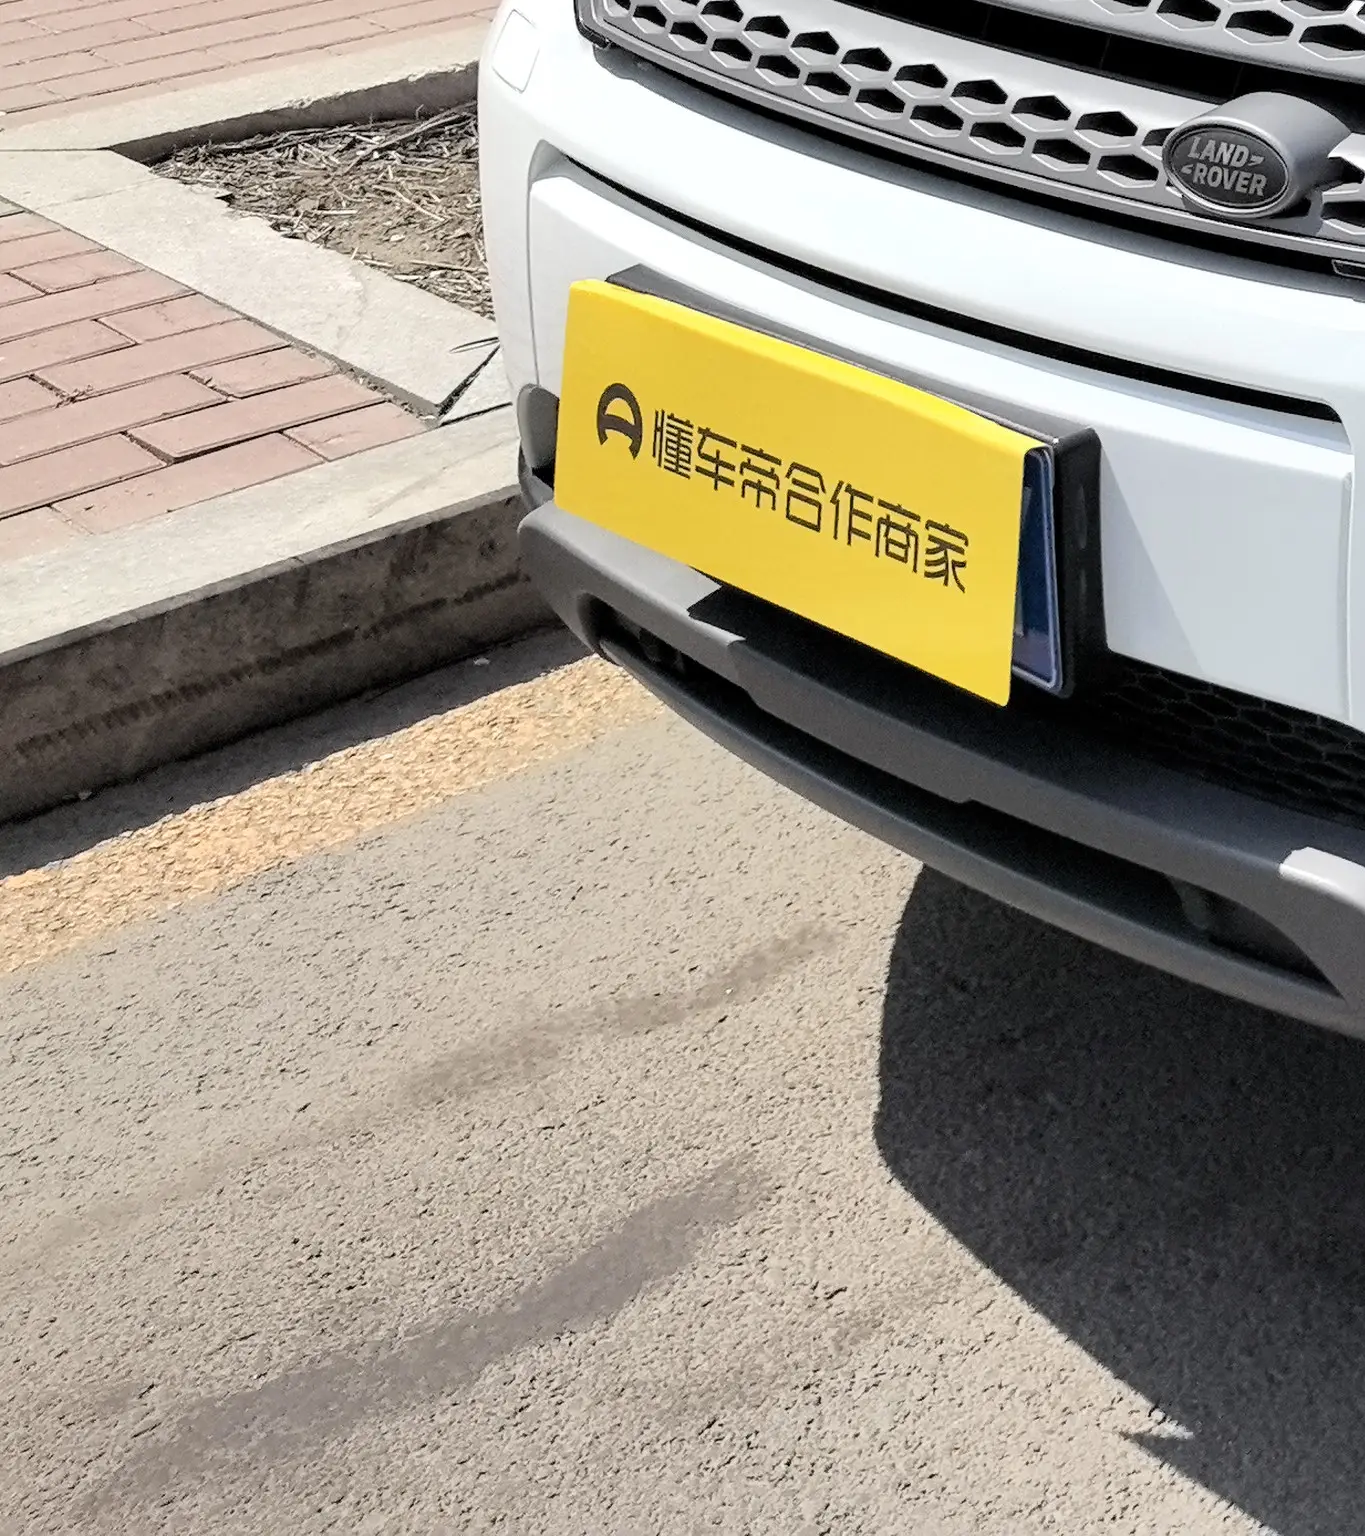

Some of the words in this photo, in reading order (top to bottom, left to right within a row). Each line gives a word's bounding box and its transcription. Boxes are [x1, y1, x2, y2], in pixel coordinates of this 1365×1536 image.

[1187, 137, 1249, 168] LAND
[1192, 163, 1268, 197] ROVER
[652, 408, 969, 594] 懂车帝合作商家
